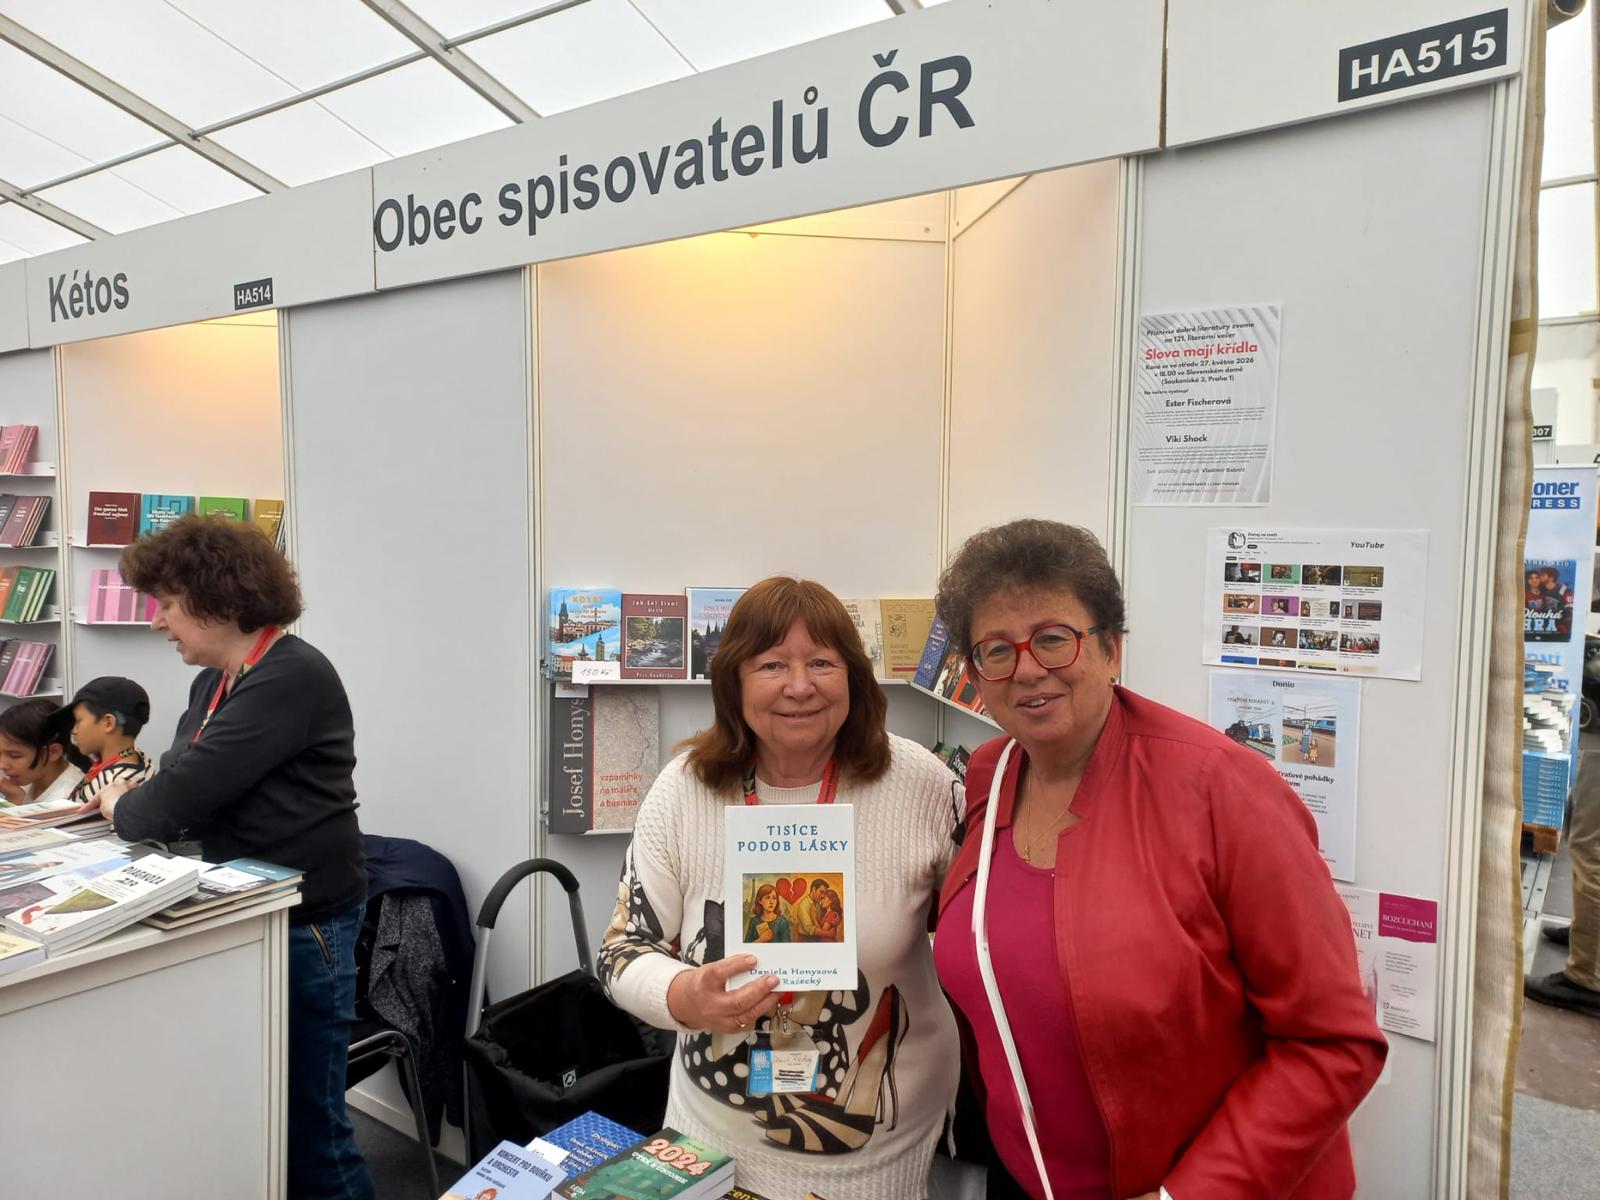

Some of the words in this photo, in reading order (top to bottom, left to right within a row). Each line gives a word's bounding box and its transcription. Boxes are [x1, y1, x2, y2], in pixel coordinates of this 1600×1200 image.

[1350, 26, 1497, 90] HA515
[374, 191, 484, 253] Obec
[497, 85, 829, 237] spisovatelů
[858, 48, 976, 148] ČR
[48, 268, 130, 323] Kétos
[236, 284, 272, 306] HA514
[1198, 324, 1230, 332] literatury
[1145, 348, 1180, 360] Slova
[1184, 344, 1214, 360] mají
[1216, 341, 1258, 355] křídla
[1187, 396, 1232, 406] Fischerová
[1183, 434, 1208, 442] Shock
[1533, 482, 1579, 496] oner
[1532, 499, 1578, 508] RESS
[1350, 541, 1385, 549] YouTube
[1272, 680, 1295, 688] Donio
[563, 699, 590, 760] Honys
[1277, 771, 1302, 780] raťové
[1304, 774, 1334, 784] pohádky
[562, 766, 584, 818] Josef
[767, 824, 818, 836] TISÍCE
[738, 840, 792, 852] PODOB
[800, 838, 848, 852] LÁSKY
[791, 968, 838, 976] Honysová
[497, 1149, 521, 1167] KONCERT
[519, 1157, 532, 1170] PRO
[642, 1138, 712, 1176] 2024
